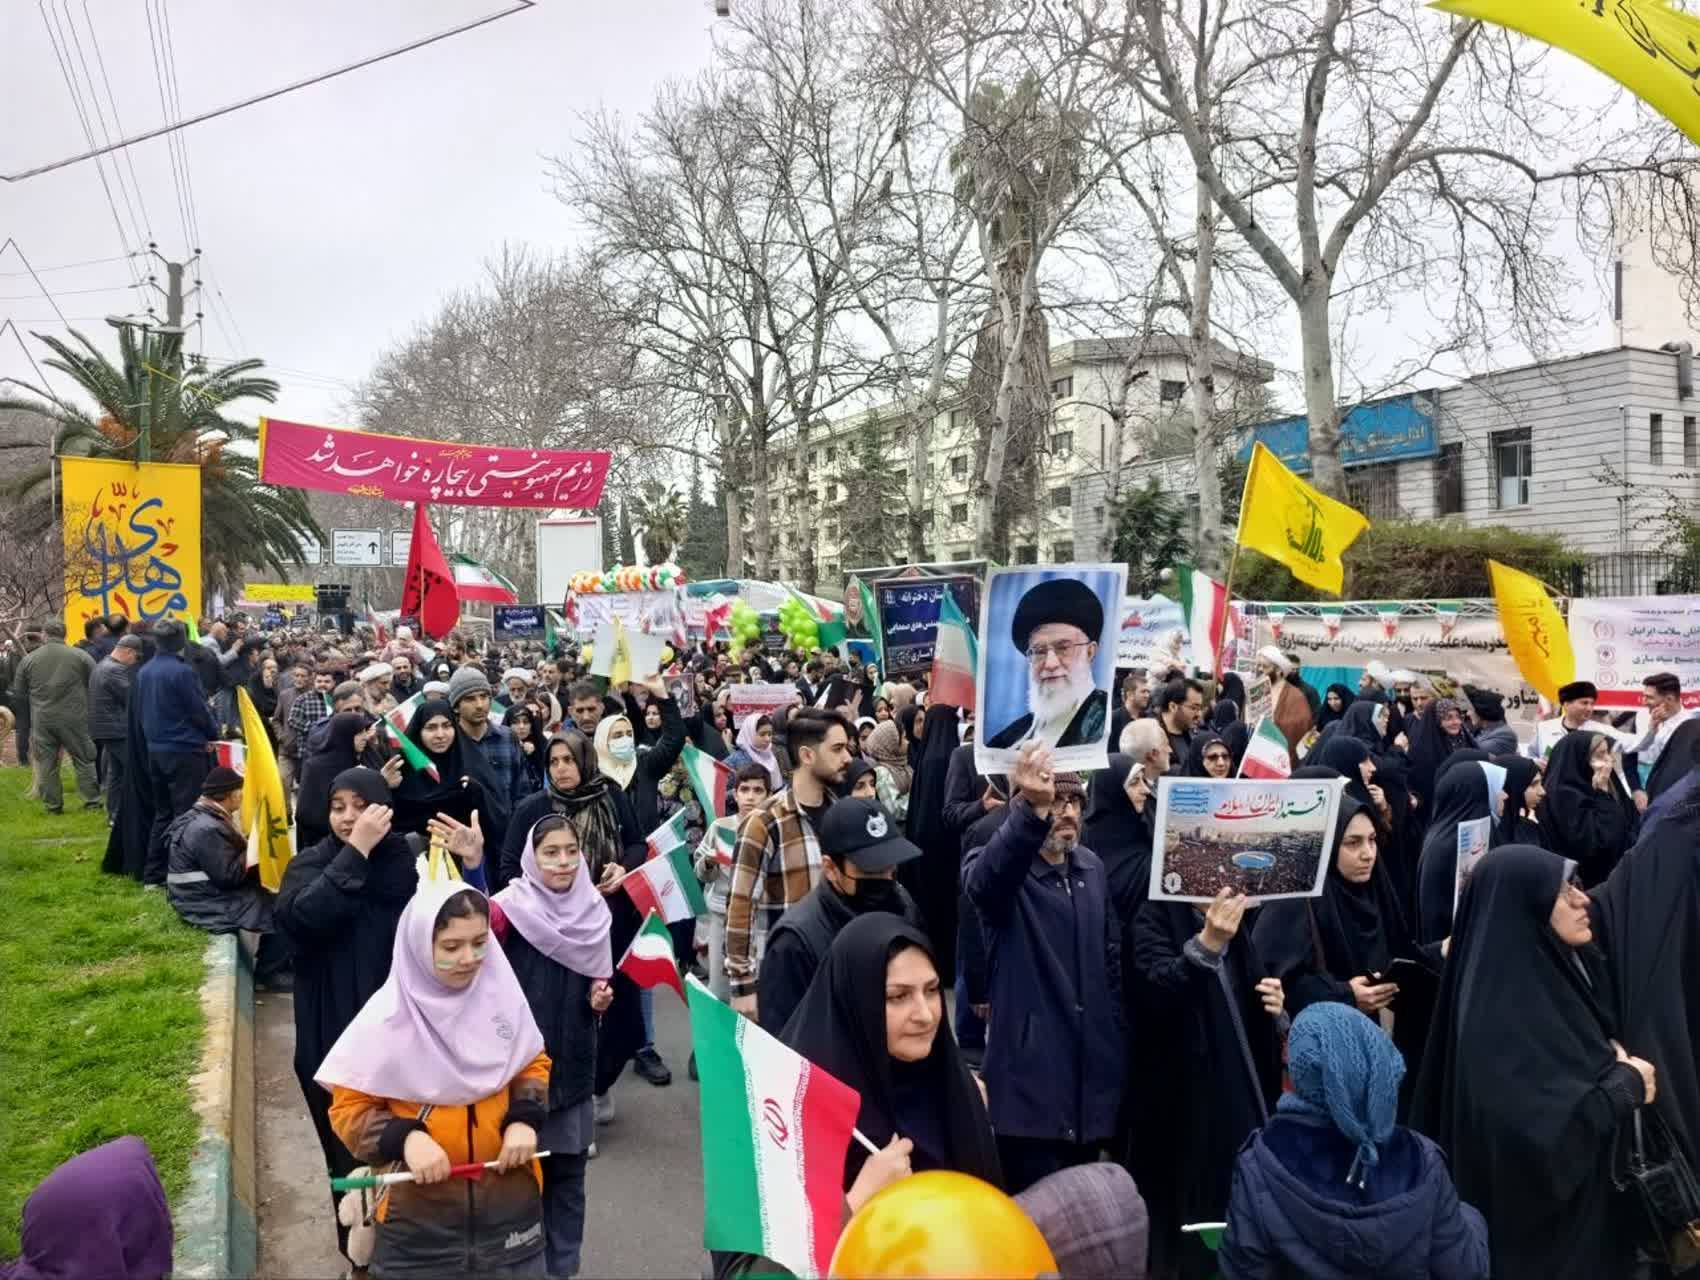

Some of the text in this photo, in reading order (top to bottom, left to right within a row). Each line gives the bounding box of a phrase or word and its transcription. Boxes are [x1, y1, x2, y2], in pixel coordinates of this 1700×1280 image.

[304, 432, 337, 463] شد
[322, 449, 422, 483] خواهد
[552, 458, 593, 502] رژیم
